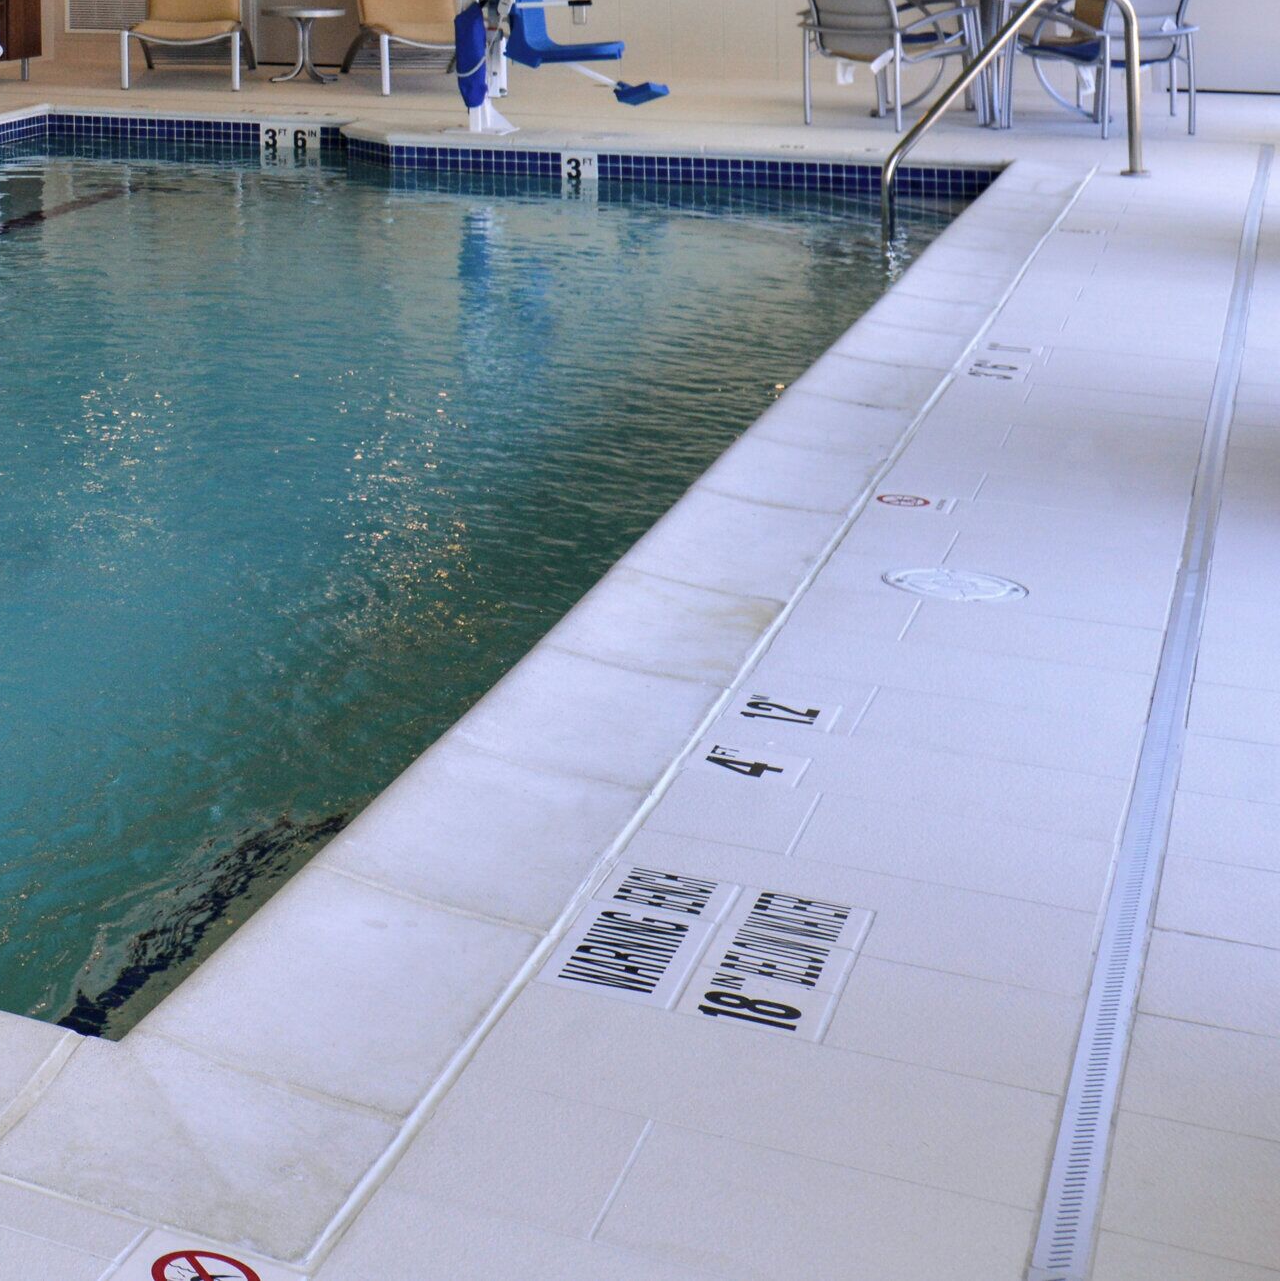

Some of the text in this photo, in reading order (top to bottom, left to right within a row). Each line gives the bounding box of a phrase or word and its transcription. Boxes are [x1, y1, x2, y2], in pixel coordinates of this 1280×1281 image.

[265, 128, 277, 147] 3
[278, 128, 287, 136] FT
[294, 129, 307, 148] 6
[566, 158, 593, 179] 3 FT
[705, 755, 784, 778] 4
[557, 867, 718, 994] WARNING BENCH
[698, 892, 852, 1032] 18 IN BELOW WATER
